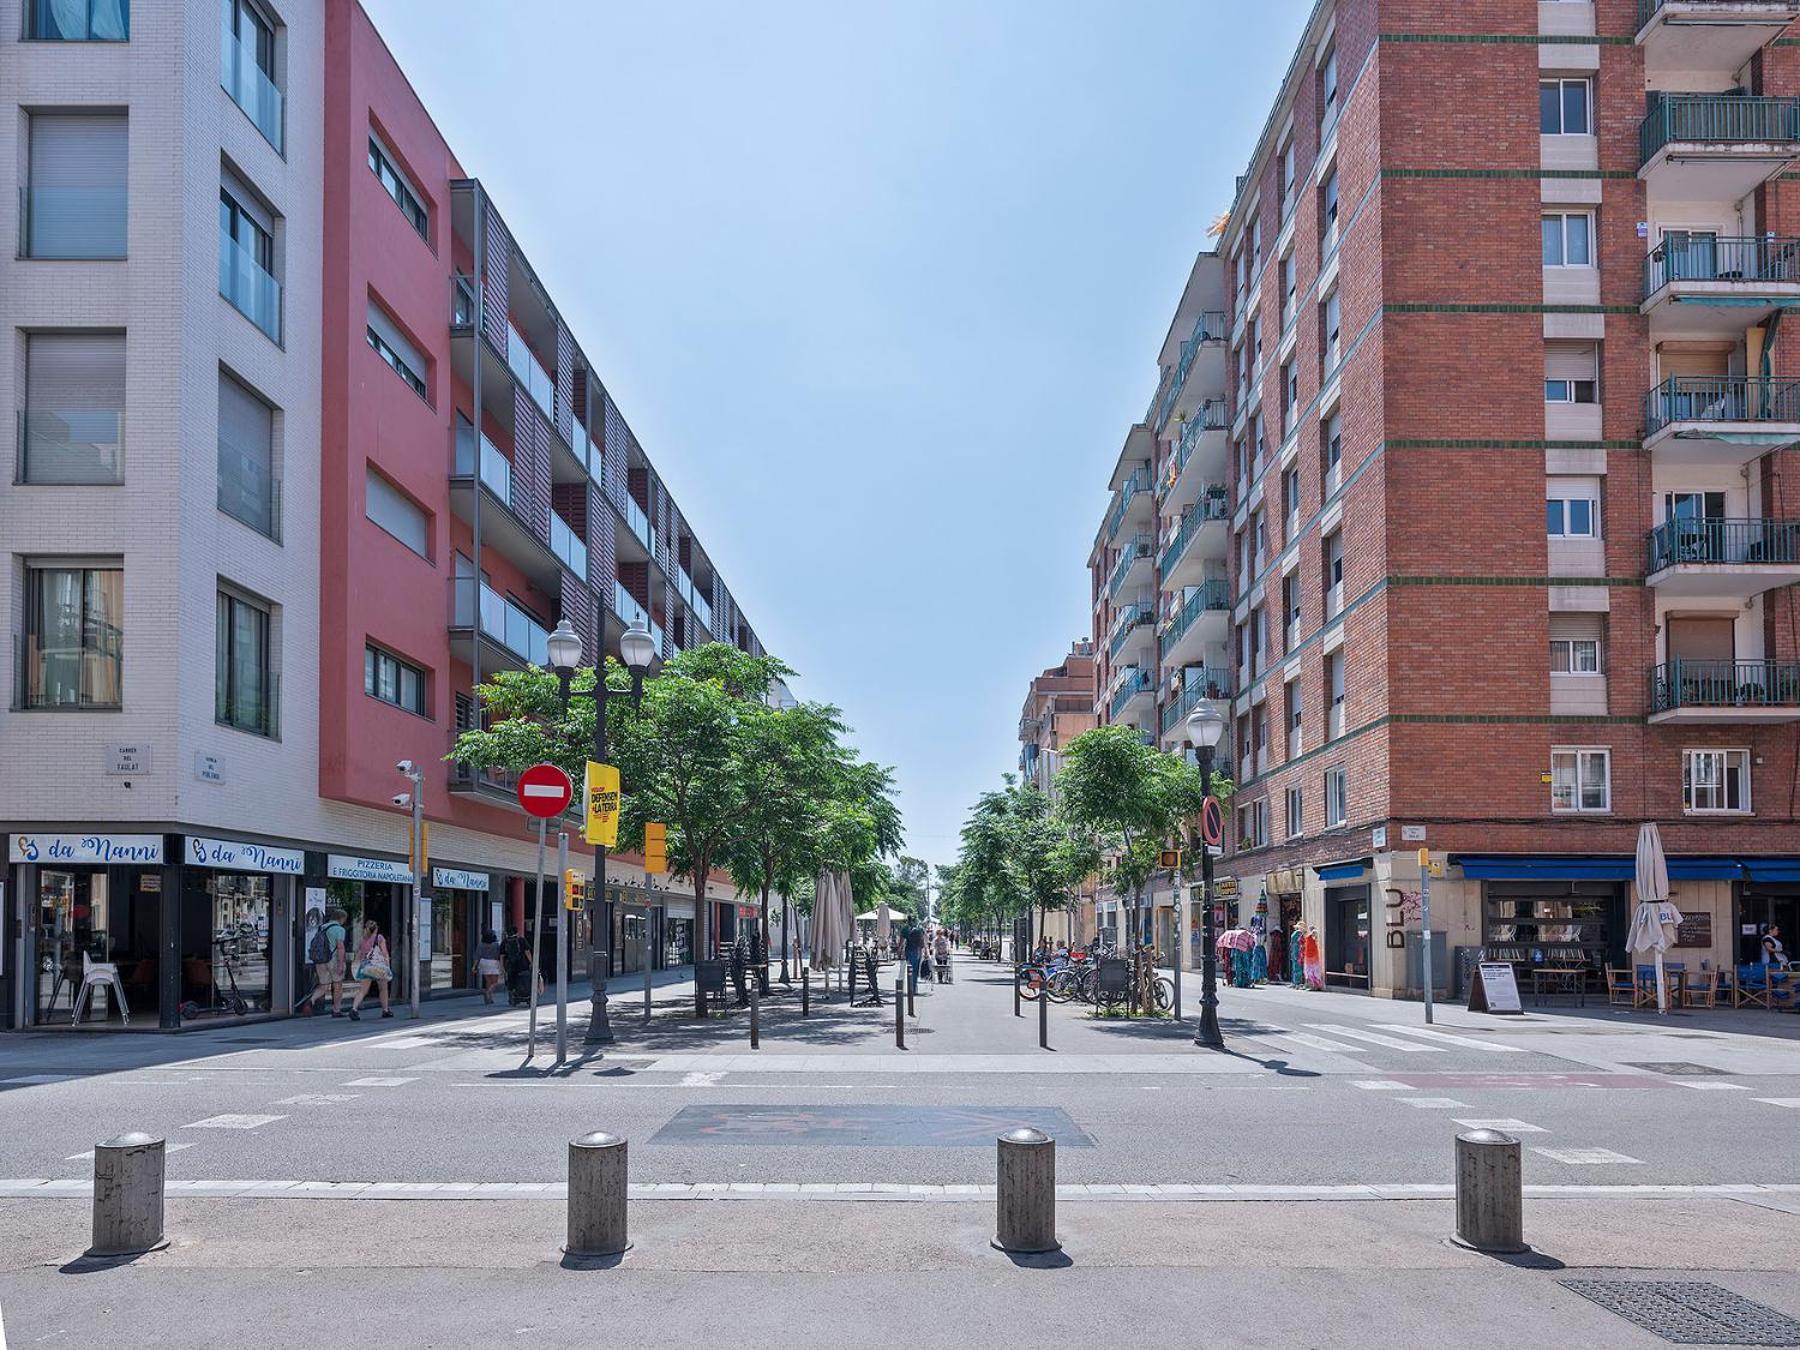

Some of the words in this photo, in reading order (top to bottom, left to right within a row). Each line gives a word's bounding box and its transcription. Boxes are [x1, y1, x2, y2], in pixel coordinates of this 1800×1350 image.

[49, 839, 75, 858] da
[81, 836, 158, 861] Nanni
[211, 845, 236, 863] da
[240, 845, 303, 871] Nanni
[338, 867, 376, 880] FRIGGITORIA
[356, 859, 393, 871] PIZZERIA
[1386, 888, 1405, 948] BLU
